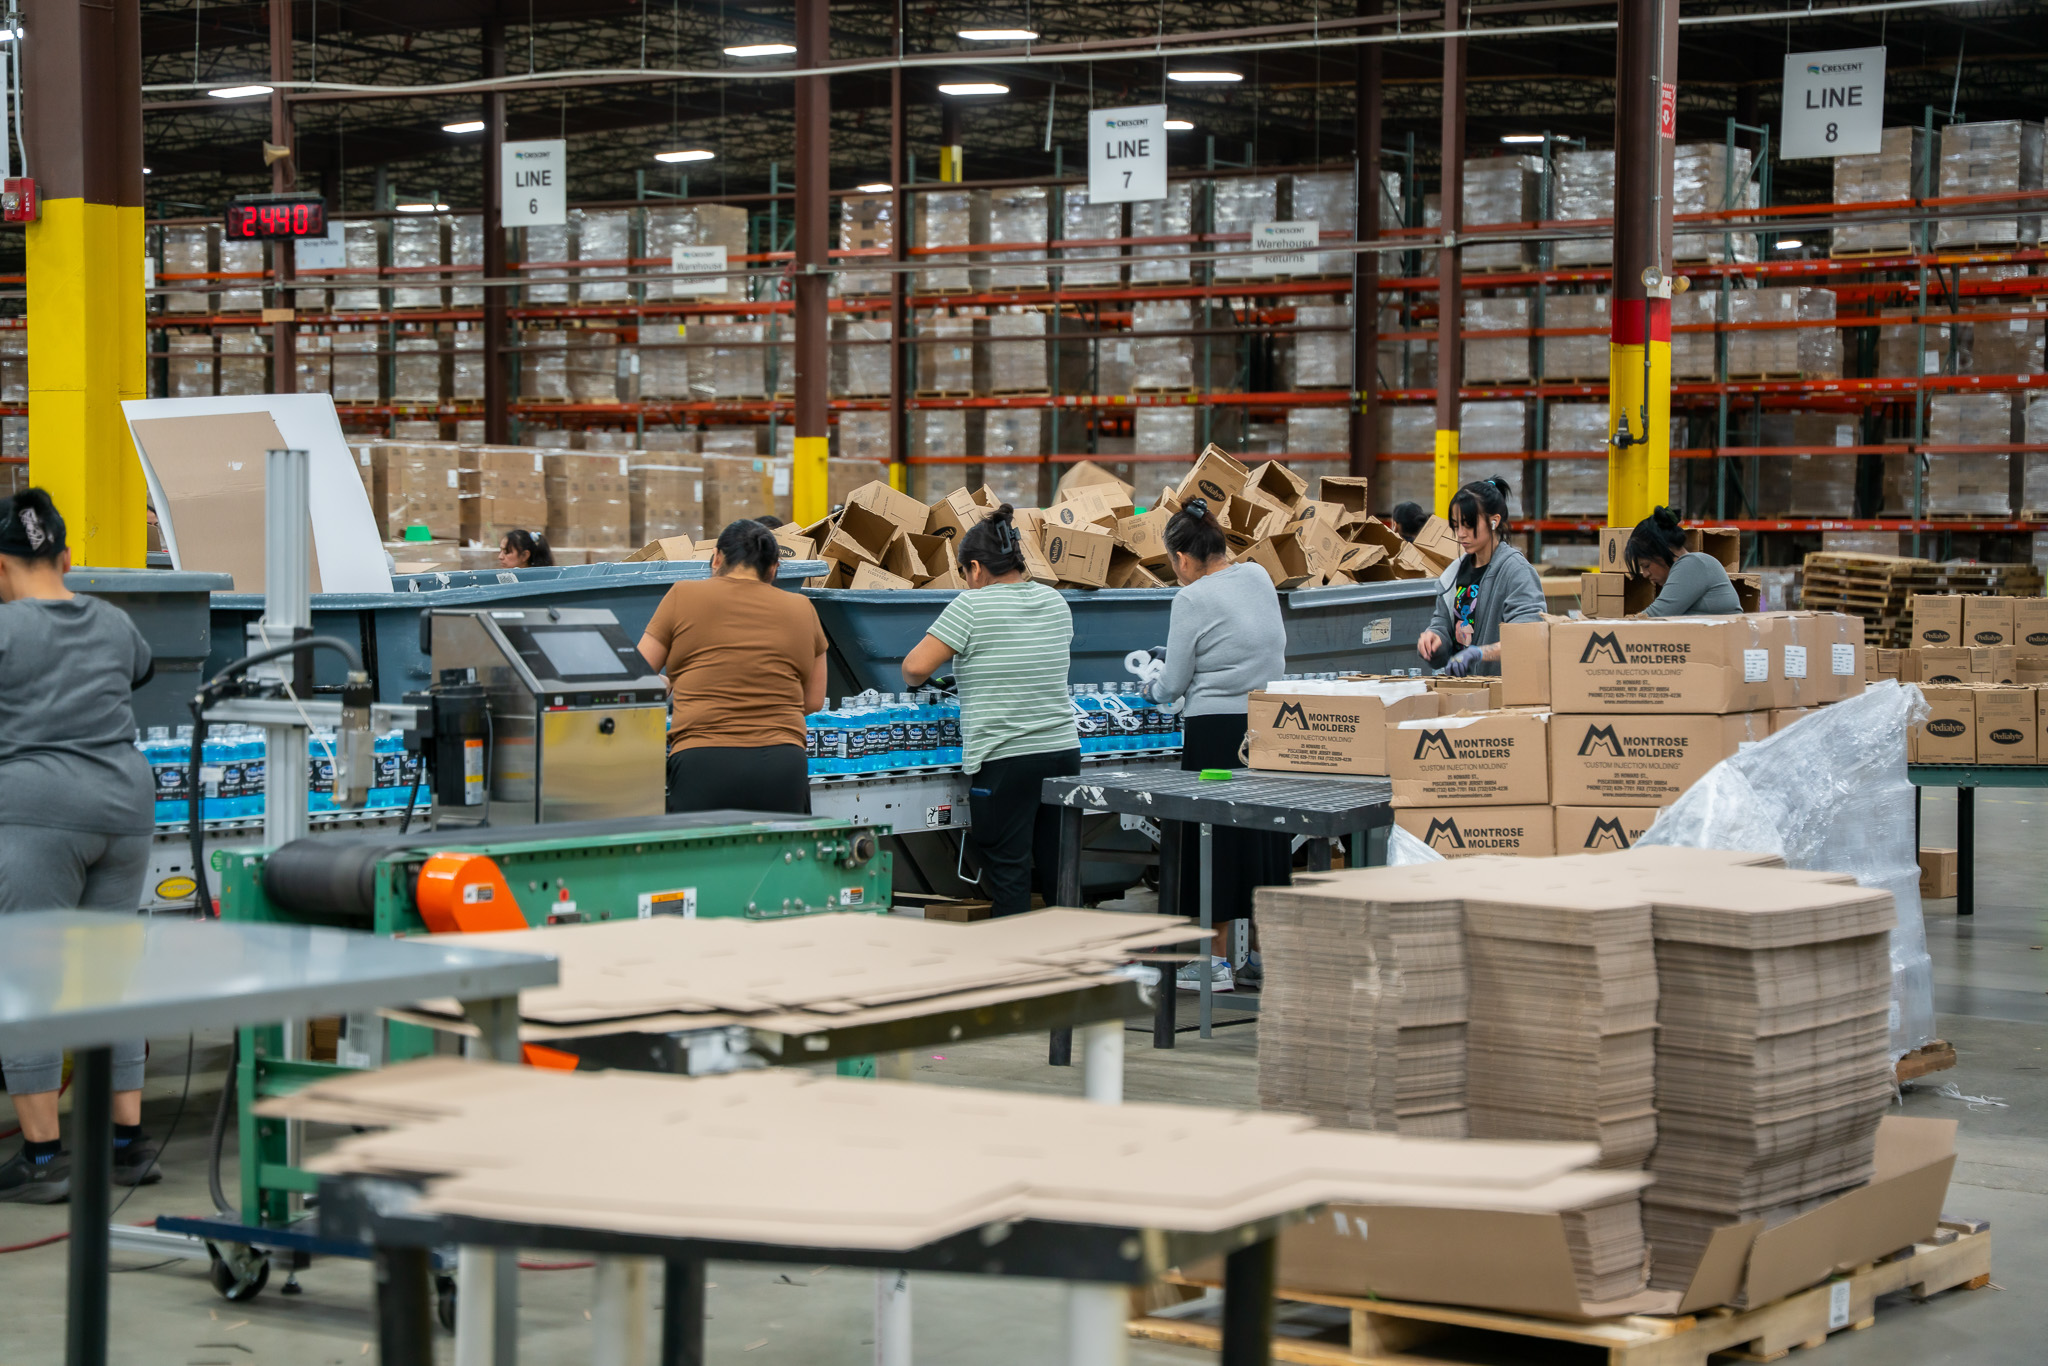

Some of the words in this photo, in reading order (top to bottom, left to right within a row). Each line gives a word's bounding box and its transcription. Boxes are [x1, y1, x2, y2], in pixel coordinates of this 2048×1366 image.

[1822, 63, 1862, 72] CRESCENT
[1806, 86, 1862, 110] LINE
[1117, 119, 1148, 127] CRESCENT
[1826, 122, 1838, 143] 8
[1106, 138, 1150, 160] LINE
[516, 170, 552, 188] LINE
[1122, 171, 1132, 188] 7
[529, 198, 538, 214] 6
[1257, 239, 1314, 248] Warehouse
[1200, 481, 1226, 501] Pedialyte
[1050, 537, 1060, 562] Pedialyte
[1926, 632, 1949, 641] Pedialyte
[1626, 644, 1691, 653] MONTROSE
[1630, 655, 1686, 664] MOLDERS
[1308, 713, 1360, 723] MONTROSE
[1312, 723, 1356, 733] MOLDERS
[1930, 724, 1964, 733] Pedialyte
[1623, 737, 1689, 747] MONTROSE
[1993, 733, 2022, 741] Pedialyte
[1454, 738, 1514, 748] MONTROSE
[1459, 749, 1510, 759] MOLDERS
[1628, 748, 1684, 758] MOLDERS
[1464, 828, 1524, 837] MONTROSE
[1468, 839, 1520, 848] MOLDERS
